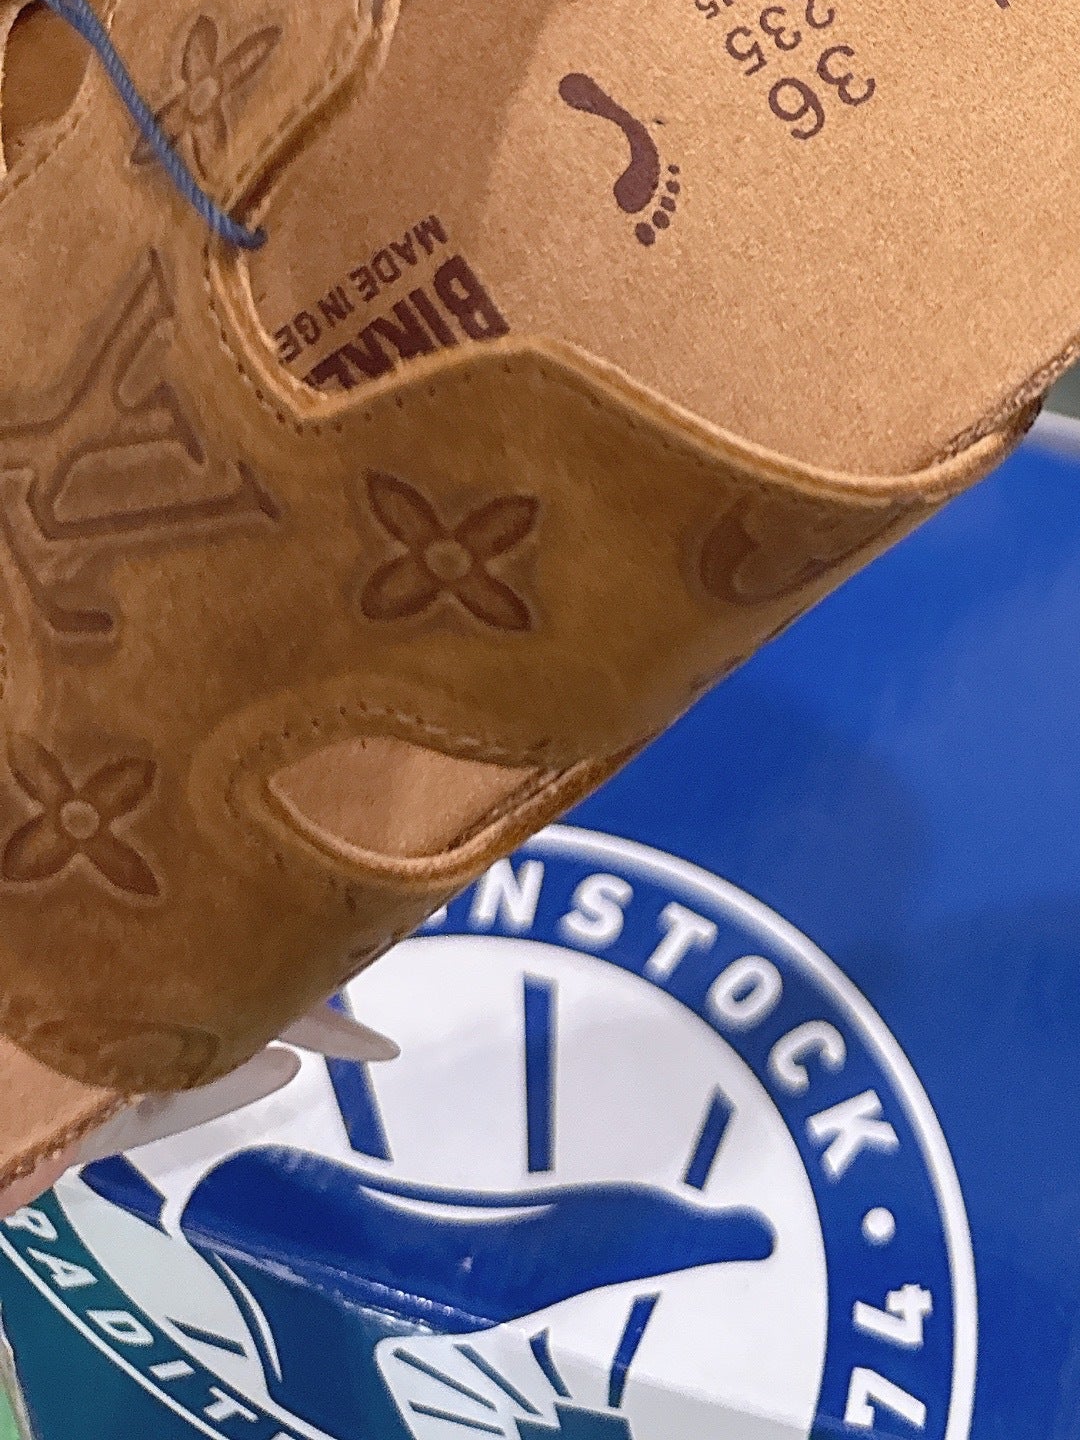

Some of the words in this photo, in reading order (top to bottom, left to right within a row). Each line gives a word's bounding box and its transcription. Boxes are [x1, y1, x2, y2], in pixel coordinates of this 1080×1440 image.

[768, 45, 876, 140] 36
[349, 214, 448, 302] MADE
[317, 286, 355, 328] IN
[422, 859, 900, 1184] NSTOCK
[3, 1206, 294, 1440] RADIT
